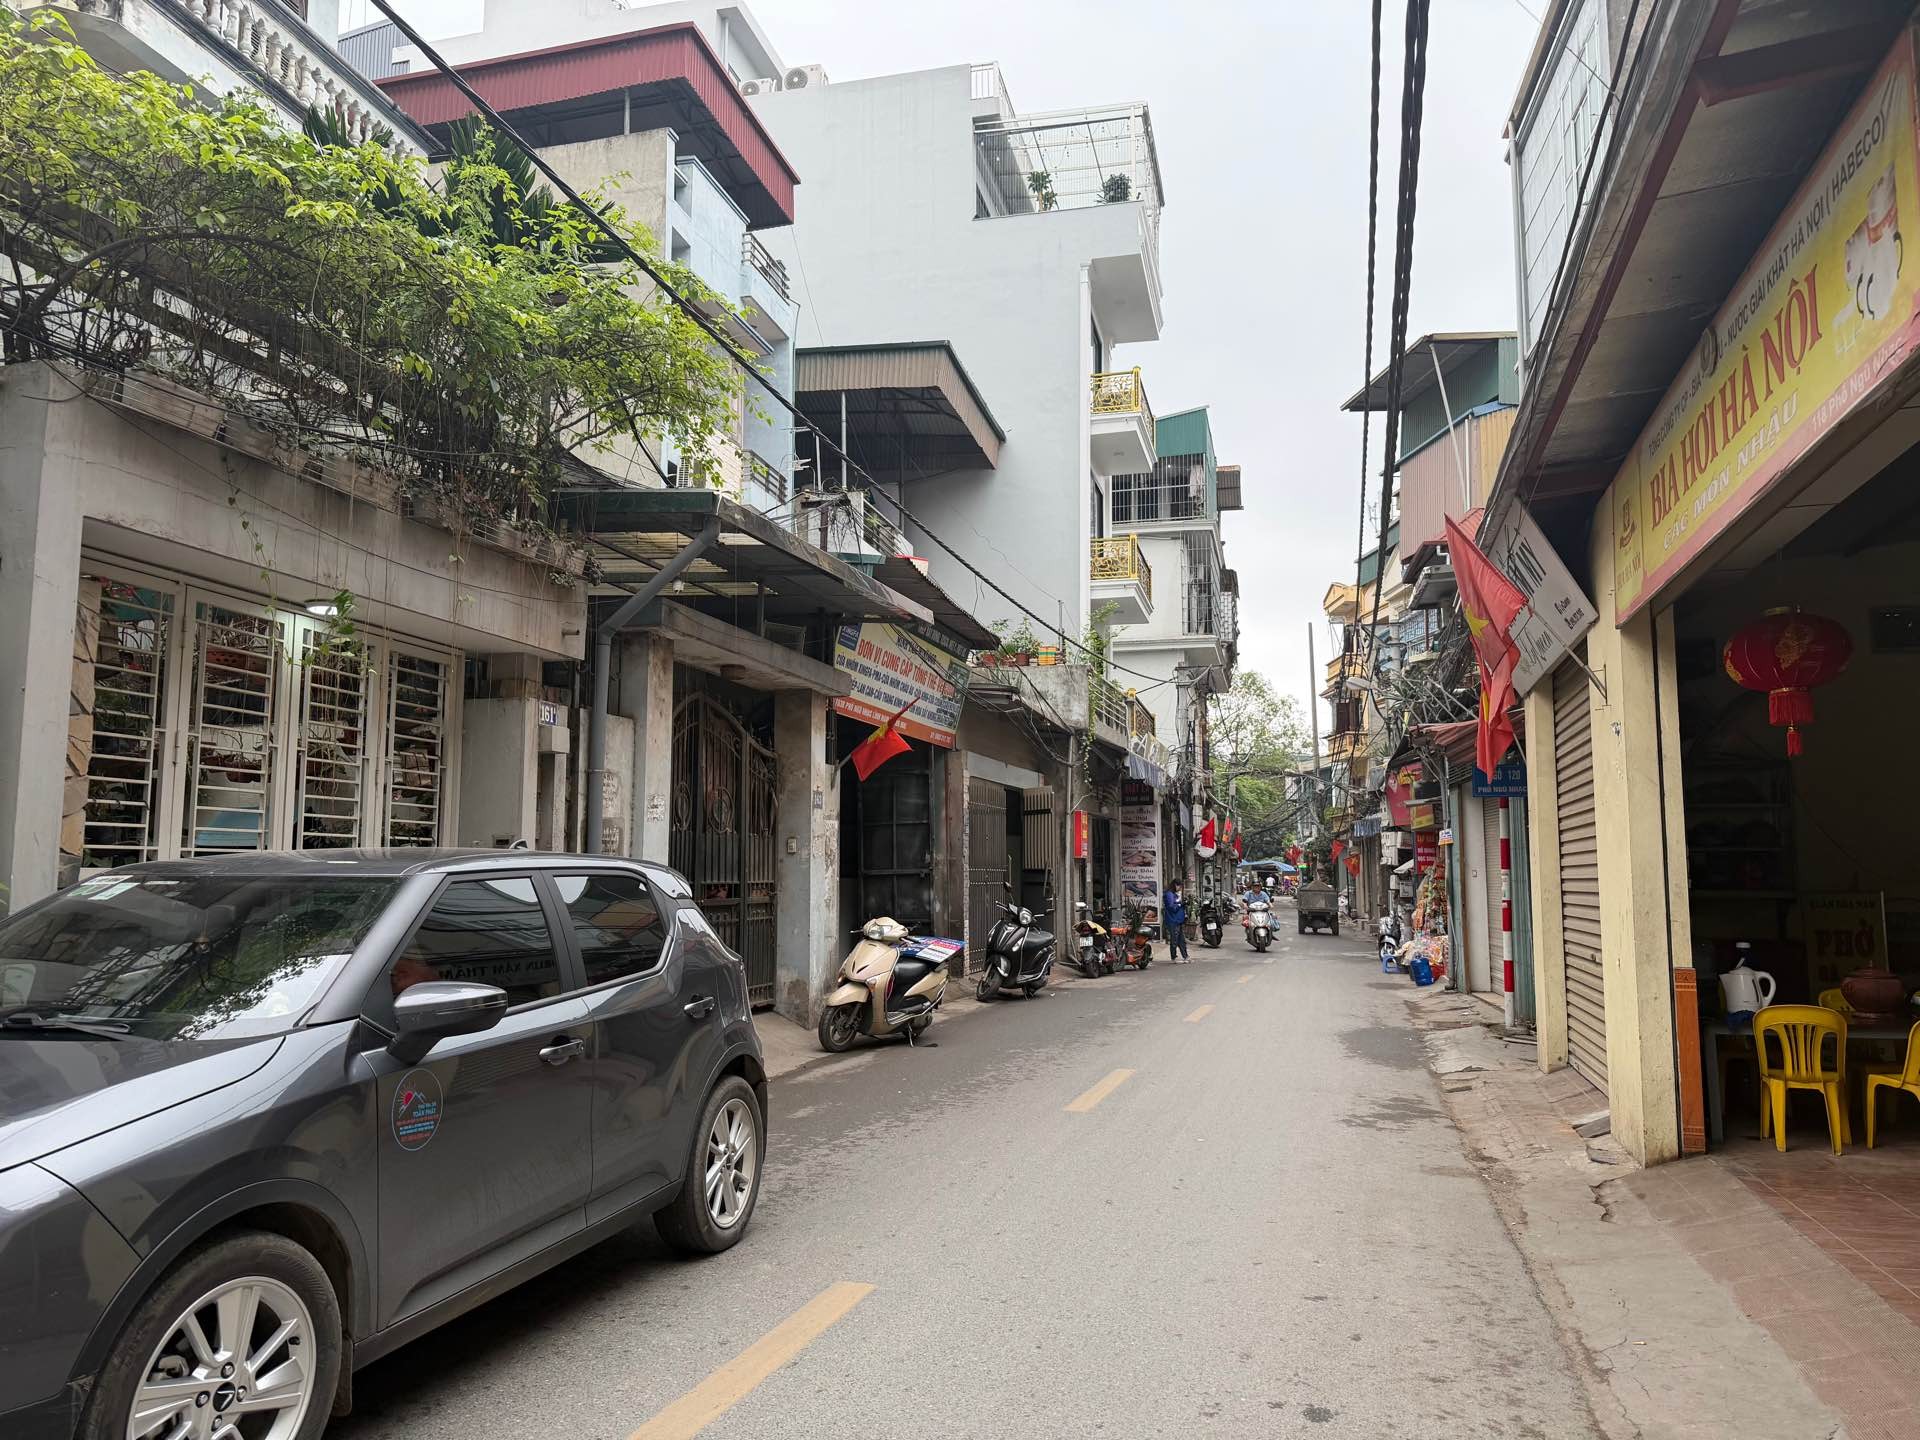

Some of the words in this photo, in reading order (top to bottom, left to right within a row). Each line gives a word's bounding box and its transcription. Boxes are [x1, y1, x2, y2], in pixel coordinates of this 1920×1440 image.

[1791, 221, 1805, 259] HÀ
[1806, 195, 1825, 239] NỘI
[1650, 452, 1681, 531] BIA
[1680, 396, 1719, 497] HƠI
[1718, 343, 1760, 451] HÀ
[1760, 263, 1823, 402] NỘI
[1663, 508, 1690, 551] CÁC
[1693, 464, 1733, 521] MÔN
